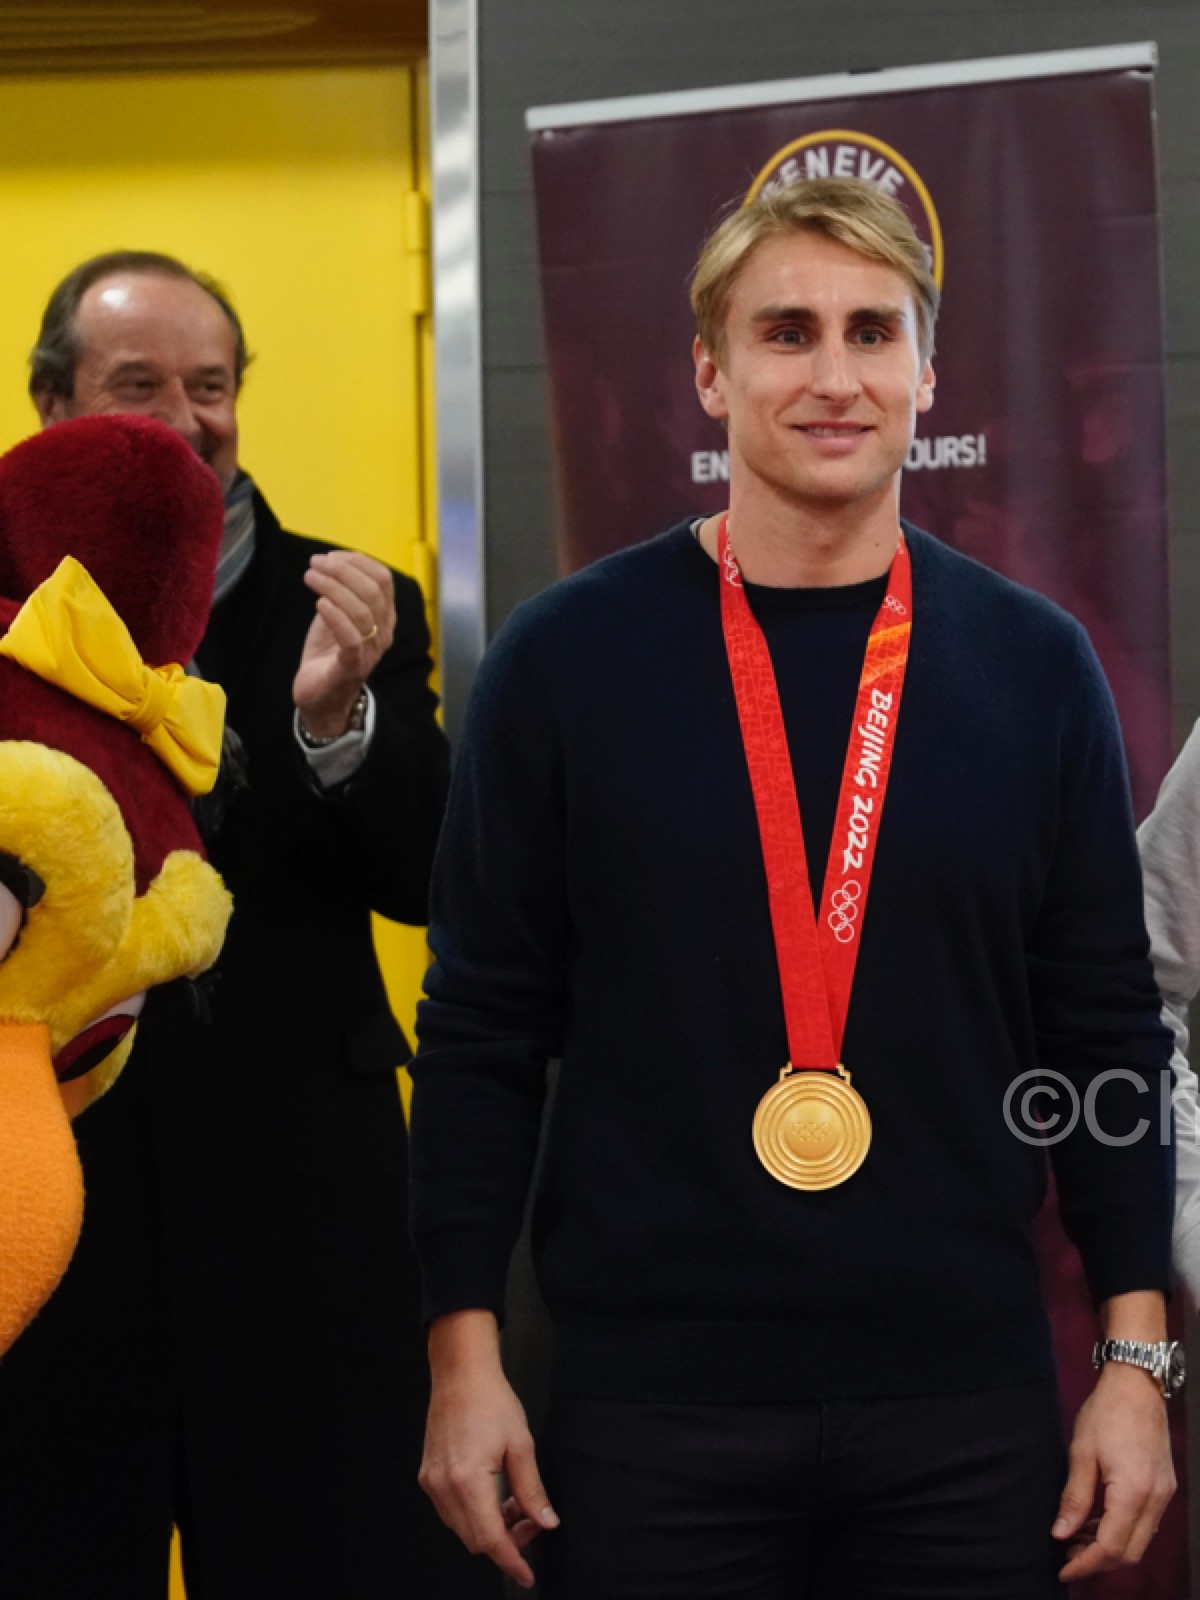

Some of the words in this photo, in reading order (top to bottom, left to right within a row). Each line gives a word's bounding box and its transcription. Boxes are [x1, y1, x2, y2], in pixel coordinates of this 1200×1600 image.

[904, 433, 987, 472] OURS!
[853, 687, 894, 790] BEIJING
[841, 794, 874, 875] 2022
